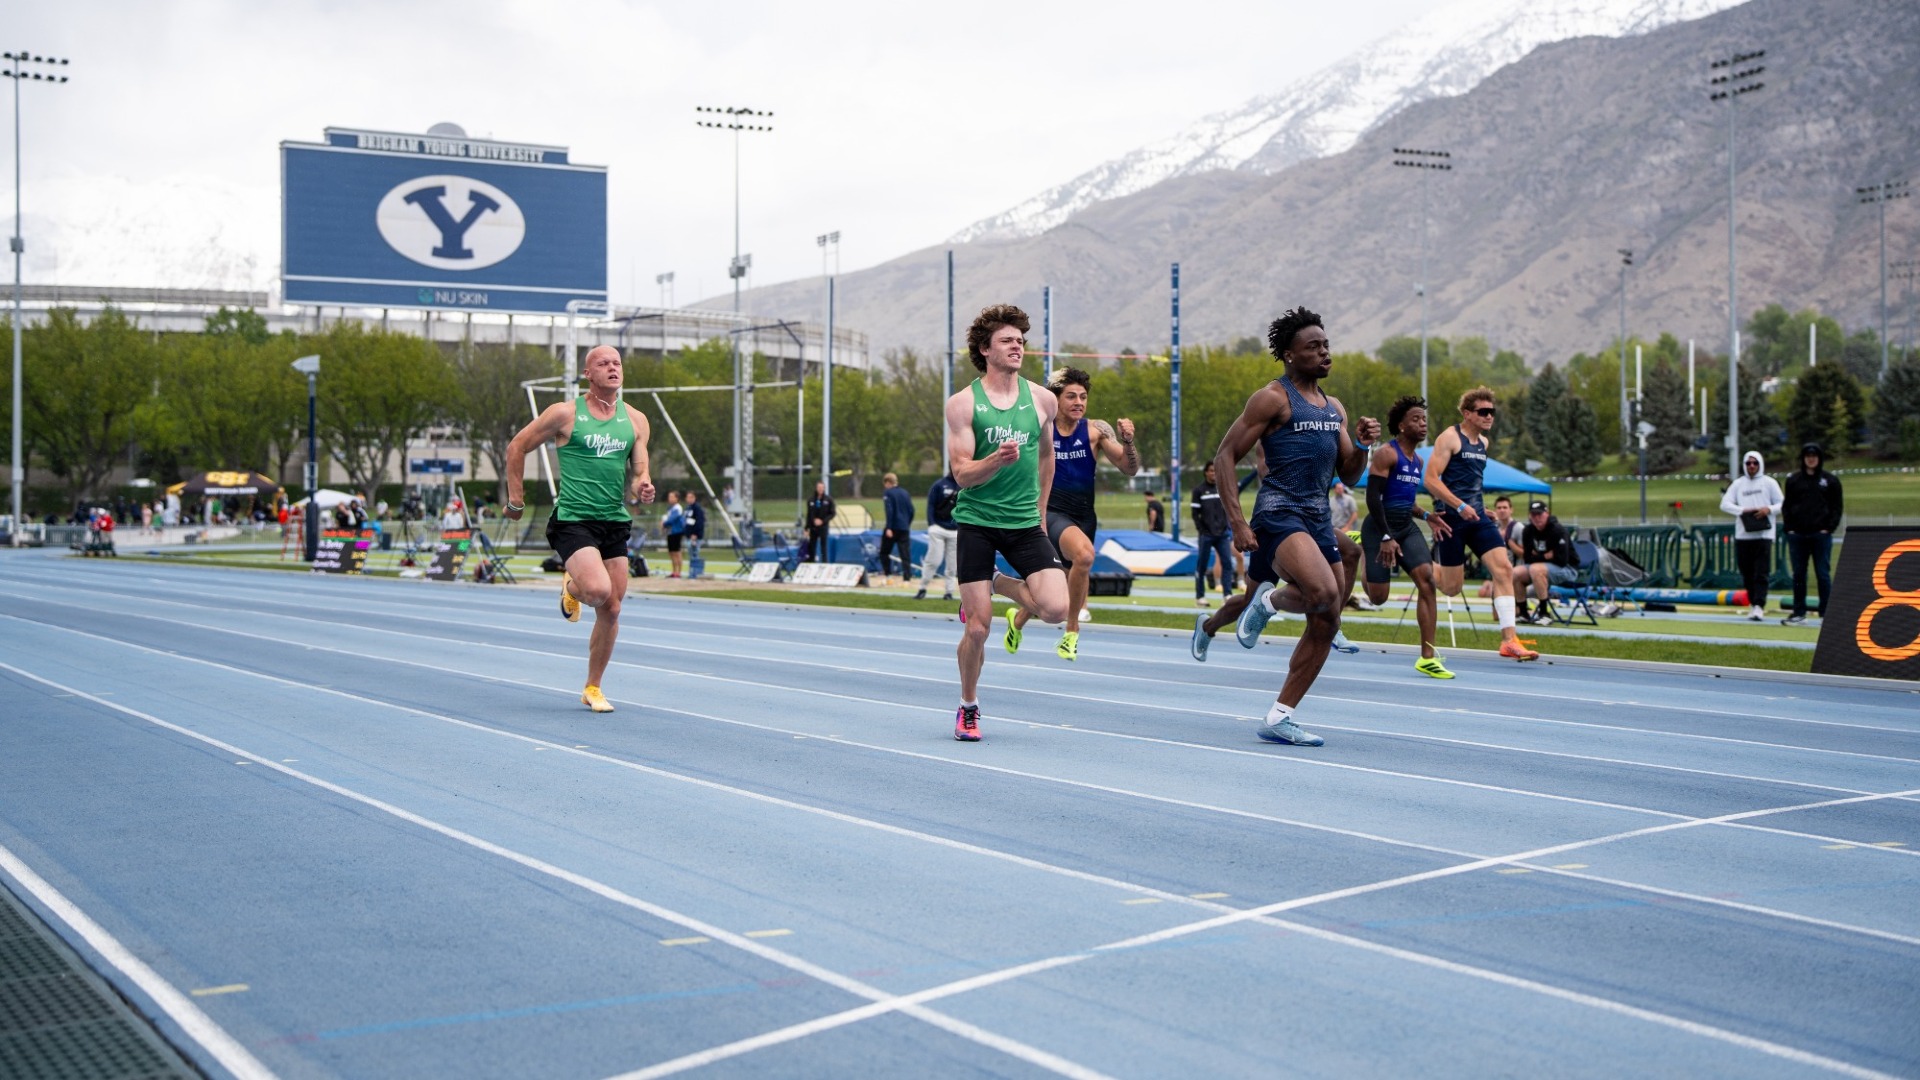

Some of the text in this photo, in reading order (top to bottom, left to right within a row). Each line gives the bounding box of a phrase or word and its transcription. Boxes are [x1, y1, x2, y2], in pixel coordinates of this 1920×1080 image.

[357, 133, 545, 163] BRIGHAM YOUNG UNIVERSITY
[403, 185, 502, 260] Y
[434, 290, 489, 305] NU SKIN
[985, 424, 1014, 444] Utah
[1294, 421, 1322, 432] UTAH
[584, 433, 611, 449] Utah
[1070, 449, 1087, 459] STATE
[1856, 538, 1920, 661] 8
